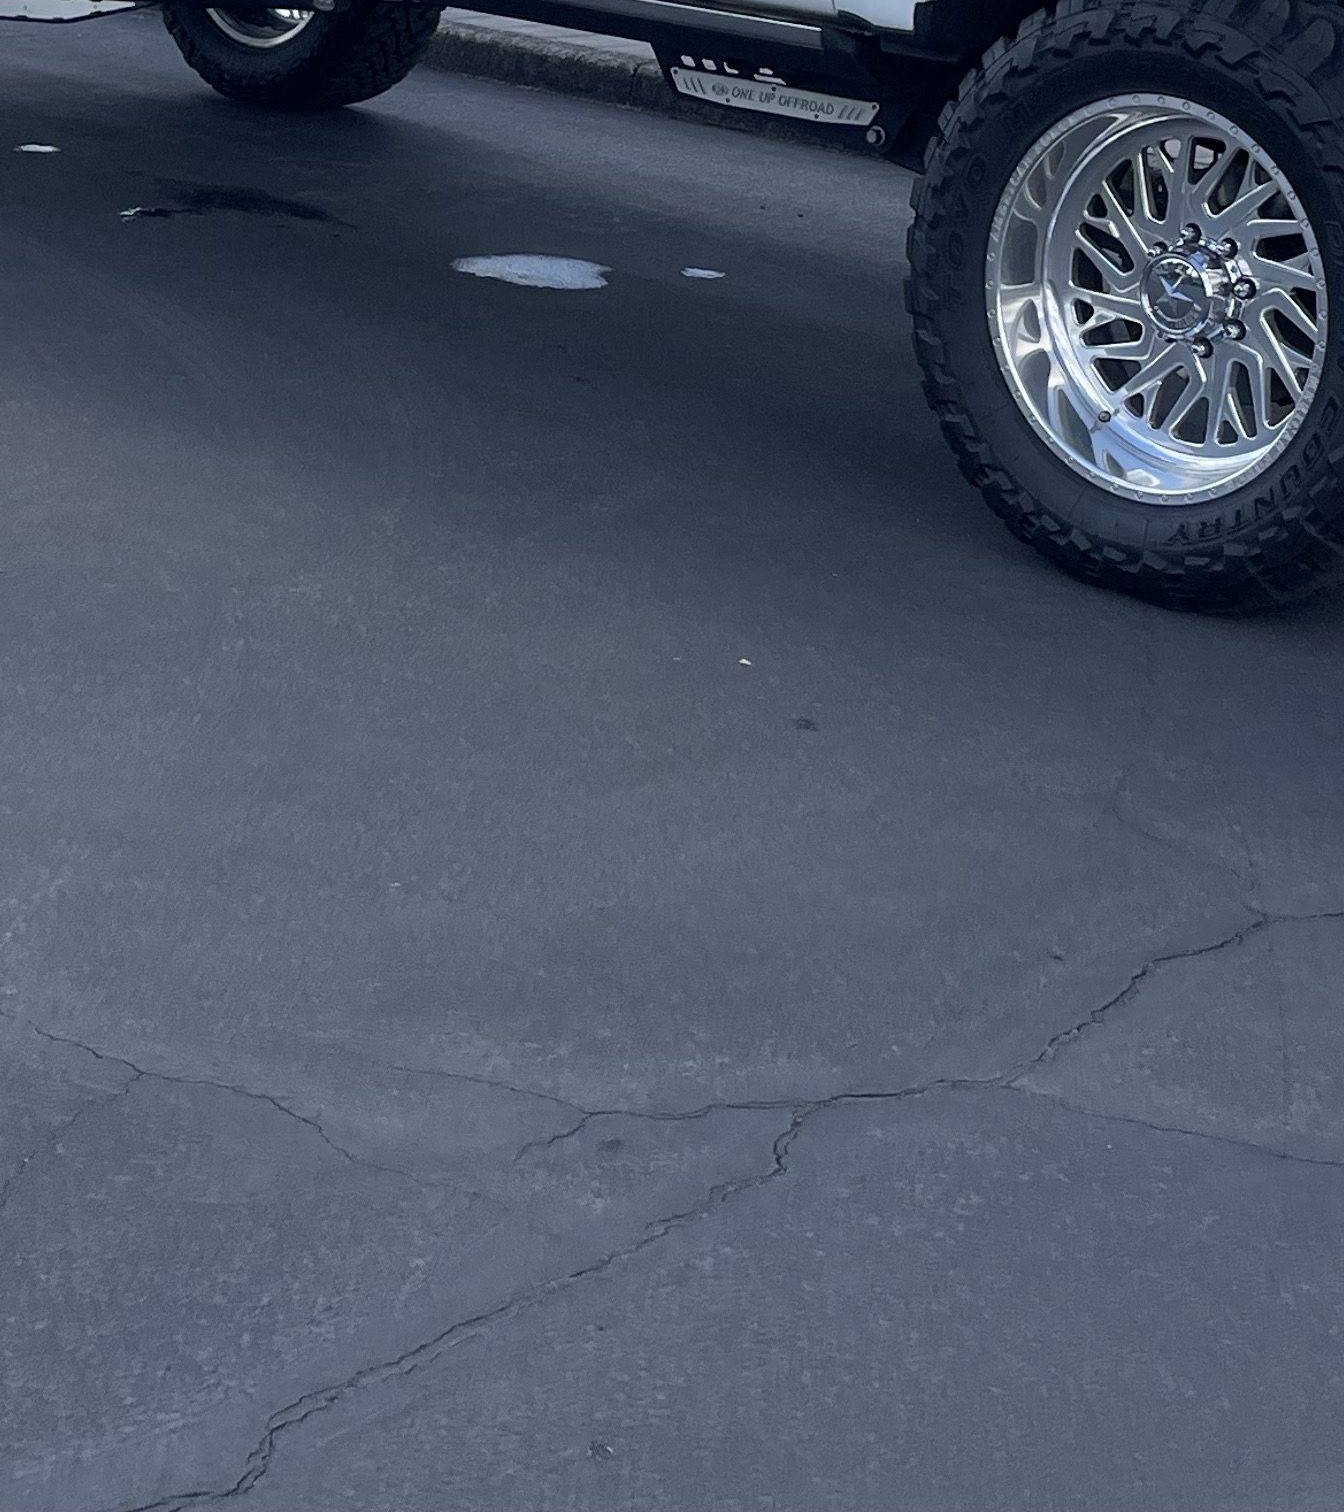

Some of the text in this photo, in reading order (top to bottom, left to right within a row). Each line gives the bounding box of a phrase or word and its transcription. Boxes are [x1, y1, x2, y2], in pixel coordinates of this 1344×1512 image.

[731, 86, 835, 115] ONE UP OFFROAD
[1166, 395, 1343, 545] COUNTRY
